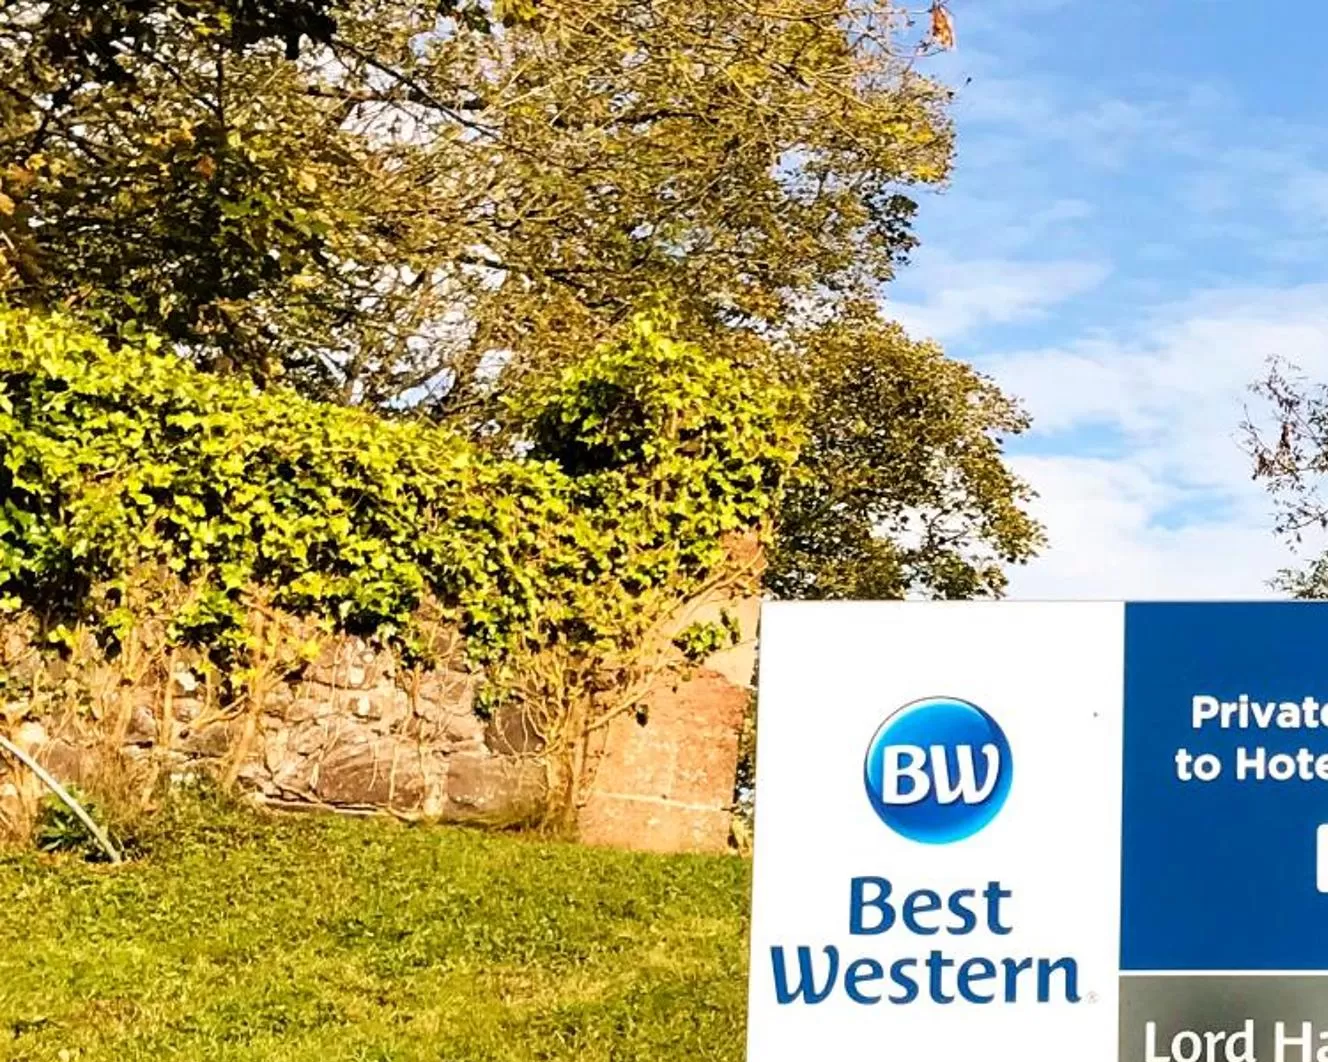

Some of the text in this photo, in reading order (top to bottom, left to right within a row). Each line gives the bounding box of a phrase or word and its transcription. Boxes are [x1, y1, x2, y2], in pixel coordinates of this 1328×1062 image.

[882, 743, 1000, 805] BW
[1176, 749, 1220, 780] to
[850, 876, 1012, 935] Best
[771, 945, 1080, 1004] Western
